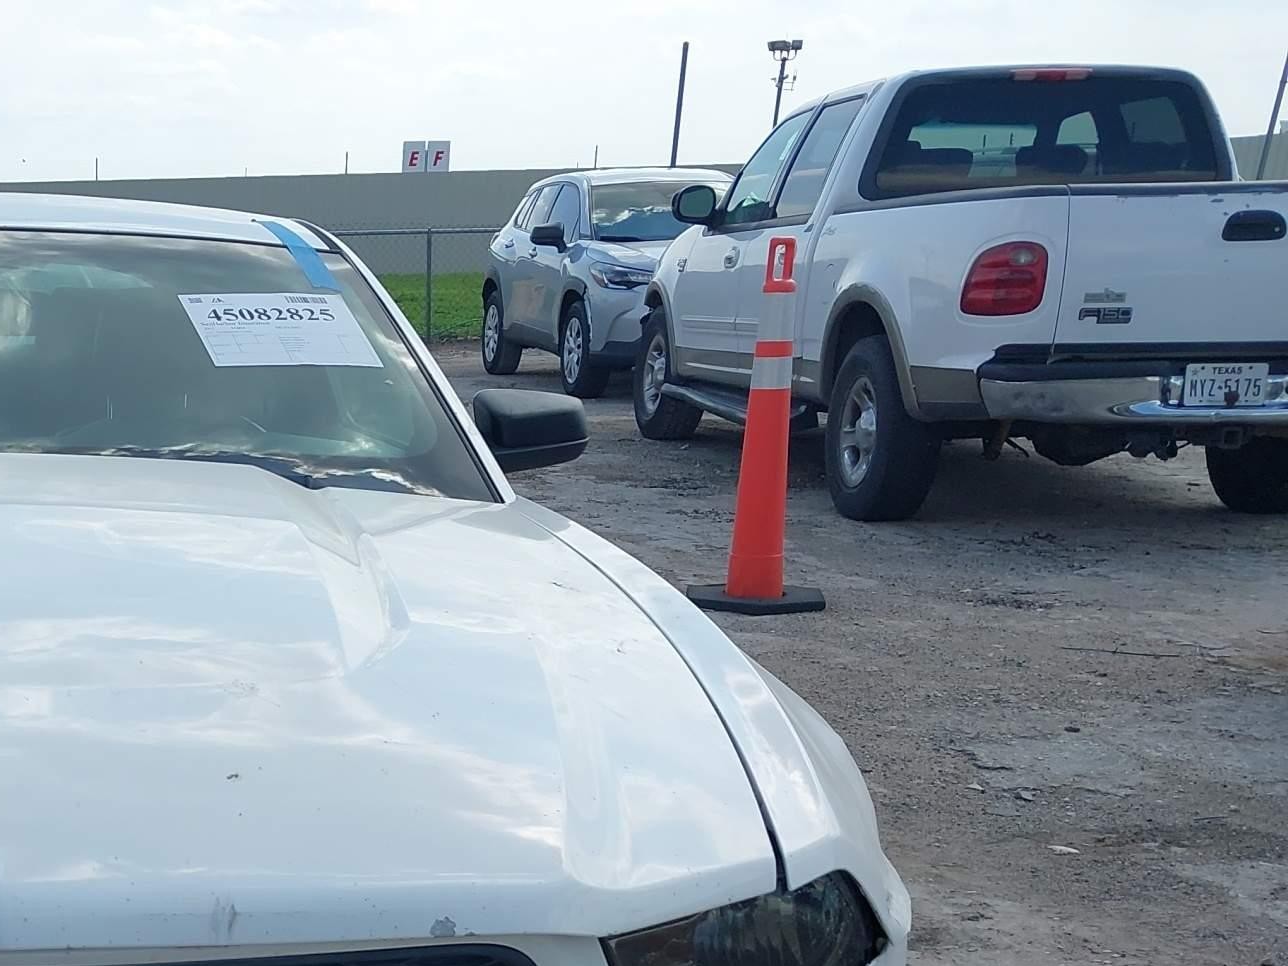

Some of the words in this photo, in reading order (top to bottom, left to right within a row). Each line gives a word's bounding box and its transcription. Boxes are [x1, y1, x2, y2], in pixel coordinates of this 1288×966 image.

[408, 150, 420, 167] E
[432, 150, 445, 167] F
[207, 307, 336, 322] 45082825
[1212, 366, 1243, 375] TEXAS
